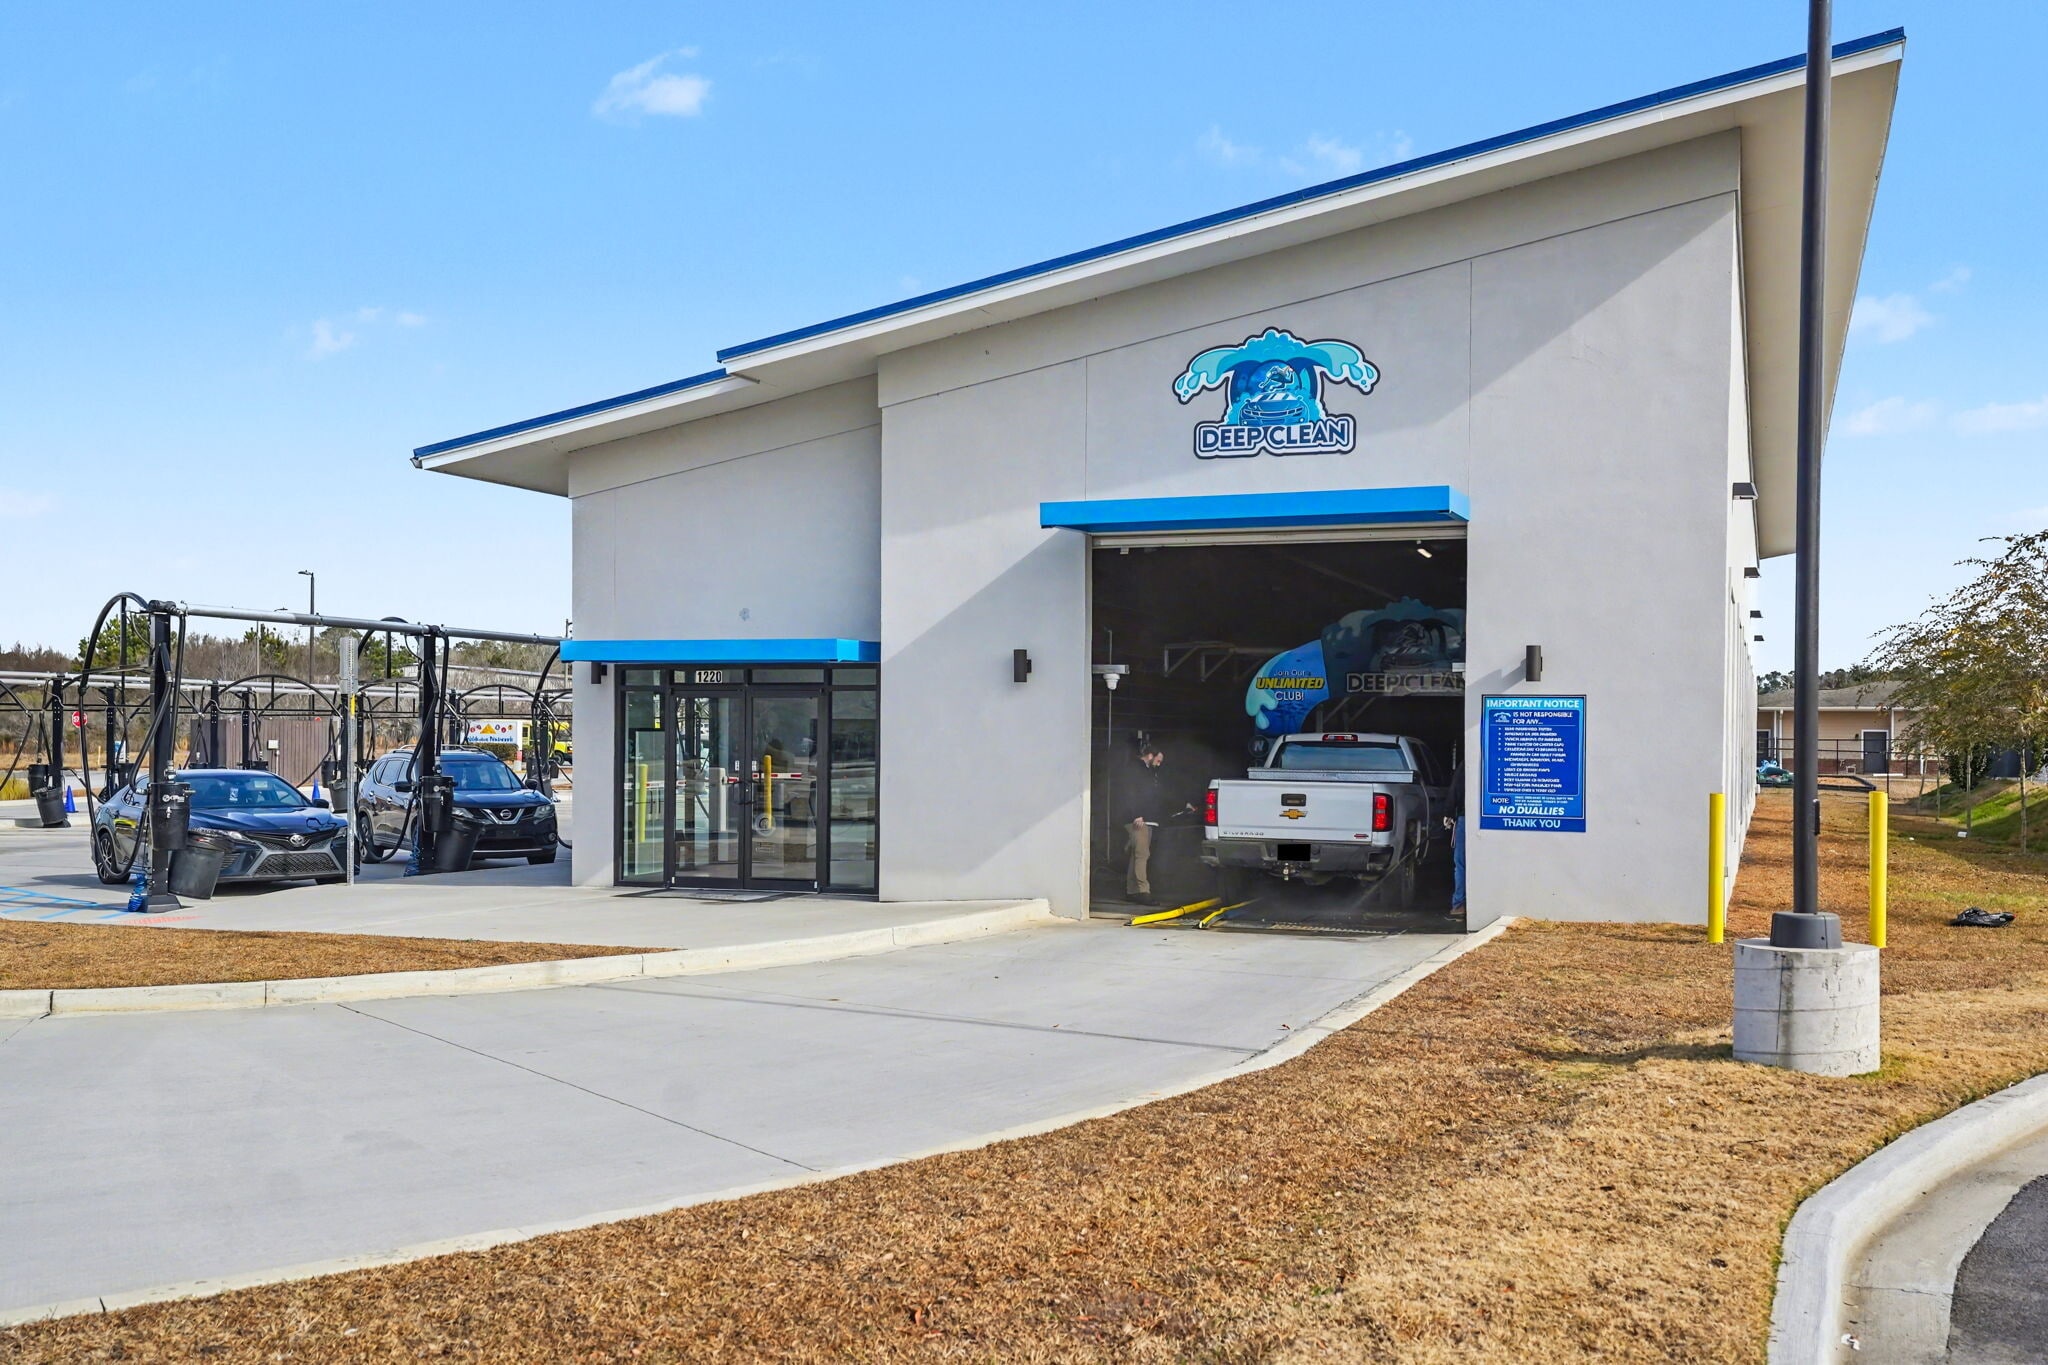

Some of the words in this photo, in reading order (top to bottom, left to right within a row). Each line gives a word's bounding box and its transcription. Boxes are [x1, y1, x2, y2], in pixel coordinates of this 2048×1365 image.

[1202, 428, 1259, 448] DEEP
[1268, 421, 1348, 445] CLEAN
[697, 671, 722, 682] 1220
[1256, 677, 1325, 689] UNLIMITED
[1347, 673, 1400, 692] DEEP
[1274, 691, 1304, 701] CLUB!
[1486, 699, 1543, 708] IMPORTANT
[1544, 699, 1580, 708] NOTICE
[1499, 806, 1515, 814] NO
[1517, 806, 1565, 815] DUALLIES
[1503, 818, 1537, 828] THANK
[1539, 819, 1561, 828] YOU
